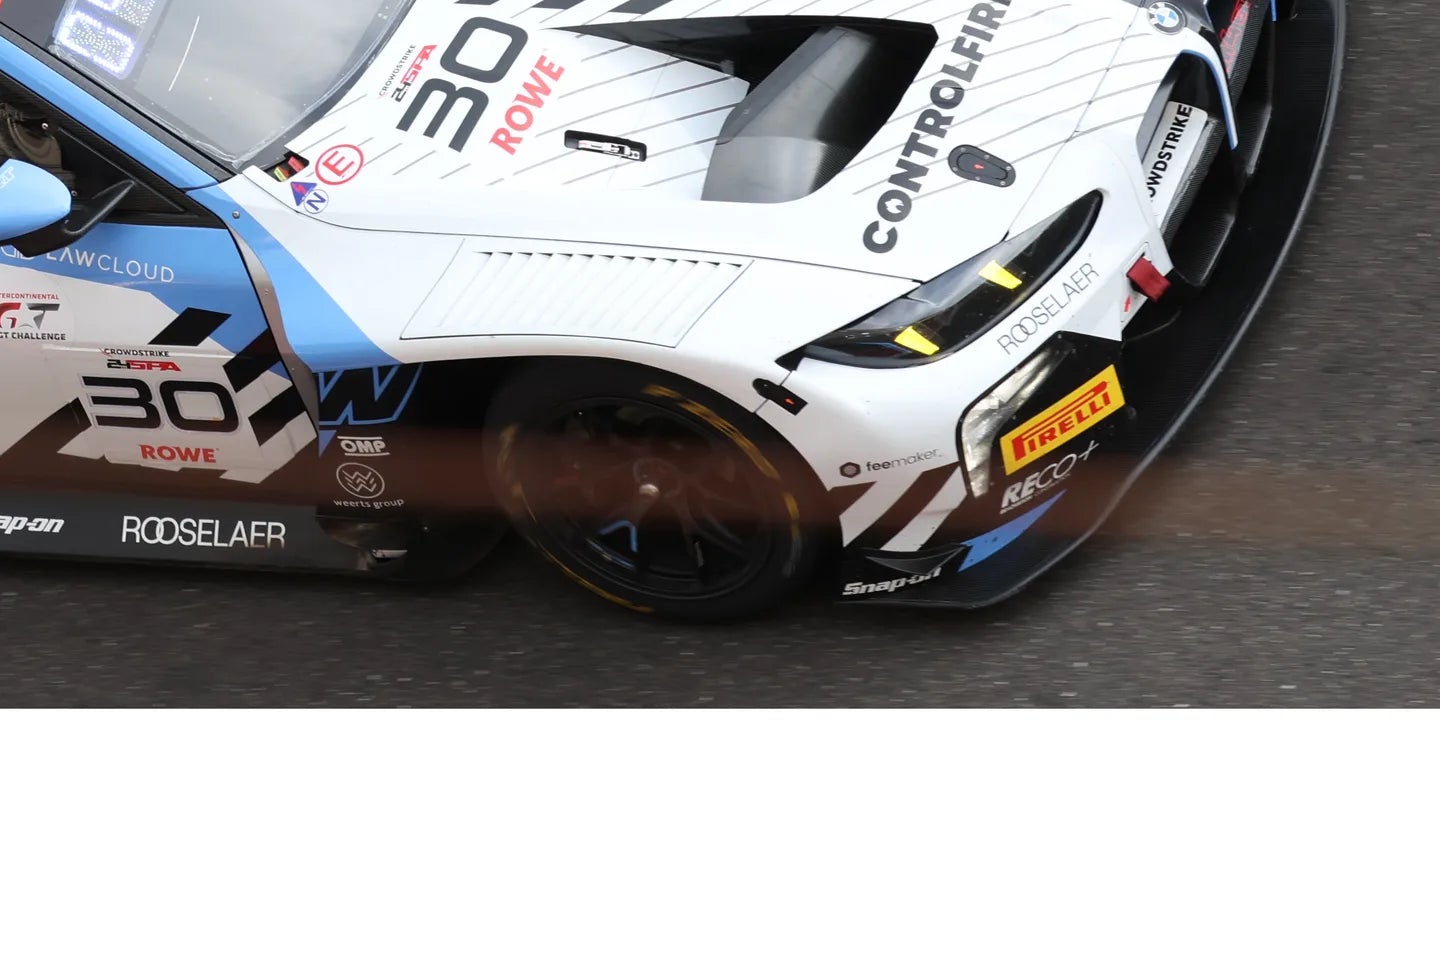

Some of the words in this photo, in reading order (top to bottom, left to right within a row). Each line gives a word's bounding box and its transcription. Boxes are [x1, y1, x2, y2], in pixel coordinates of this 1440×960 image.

[378, 43, 417, 97] CROWDSTRIKE
[395, 13, 529, 153] 30
[488, 54, 566, 155] ROWE
[321, 150, 355, 177] E
[1146, 103, 1193, 198] WDSTRIKE
[306, 191, 327, 211] N
[996, 262, 1100, 355] ROOSELAER
[12, 332, 67, 341] CHALLENGE
[104, 348, 171, 358] CROWDSTRIKE
[82, 375, 240, 433] 30
[1011, 380, 1111, 462] PIRELLI
[139, 444, 217, 464] ROWE
[340, 439, 386, 453] OMP
[333, 499, 371, 508] weerts
[373, 498, 405, 510] group
[121, 516, 286, 550] ROOSELAER
[842, 566, 942, 596] Snap-on
